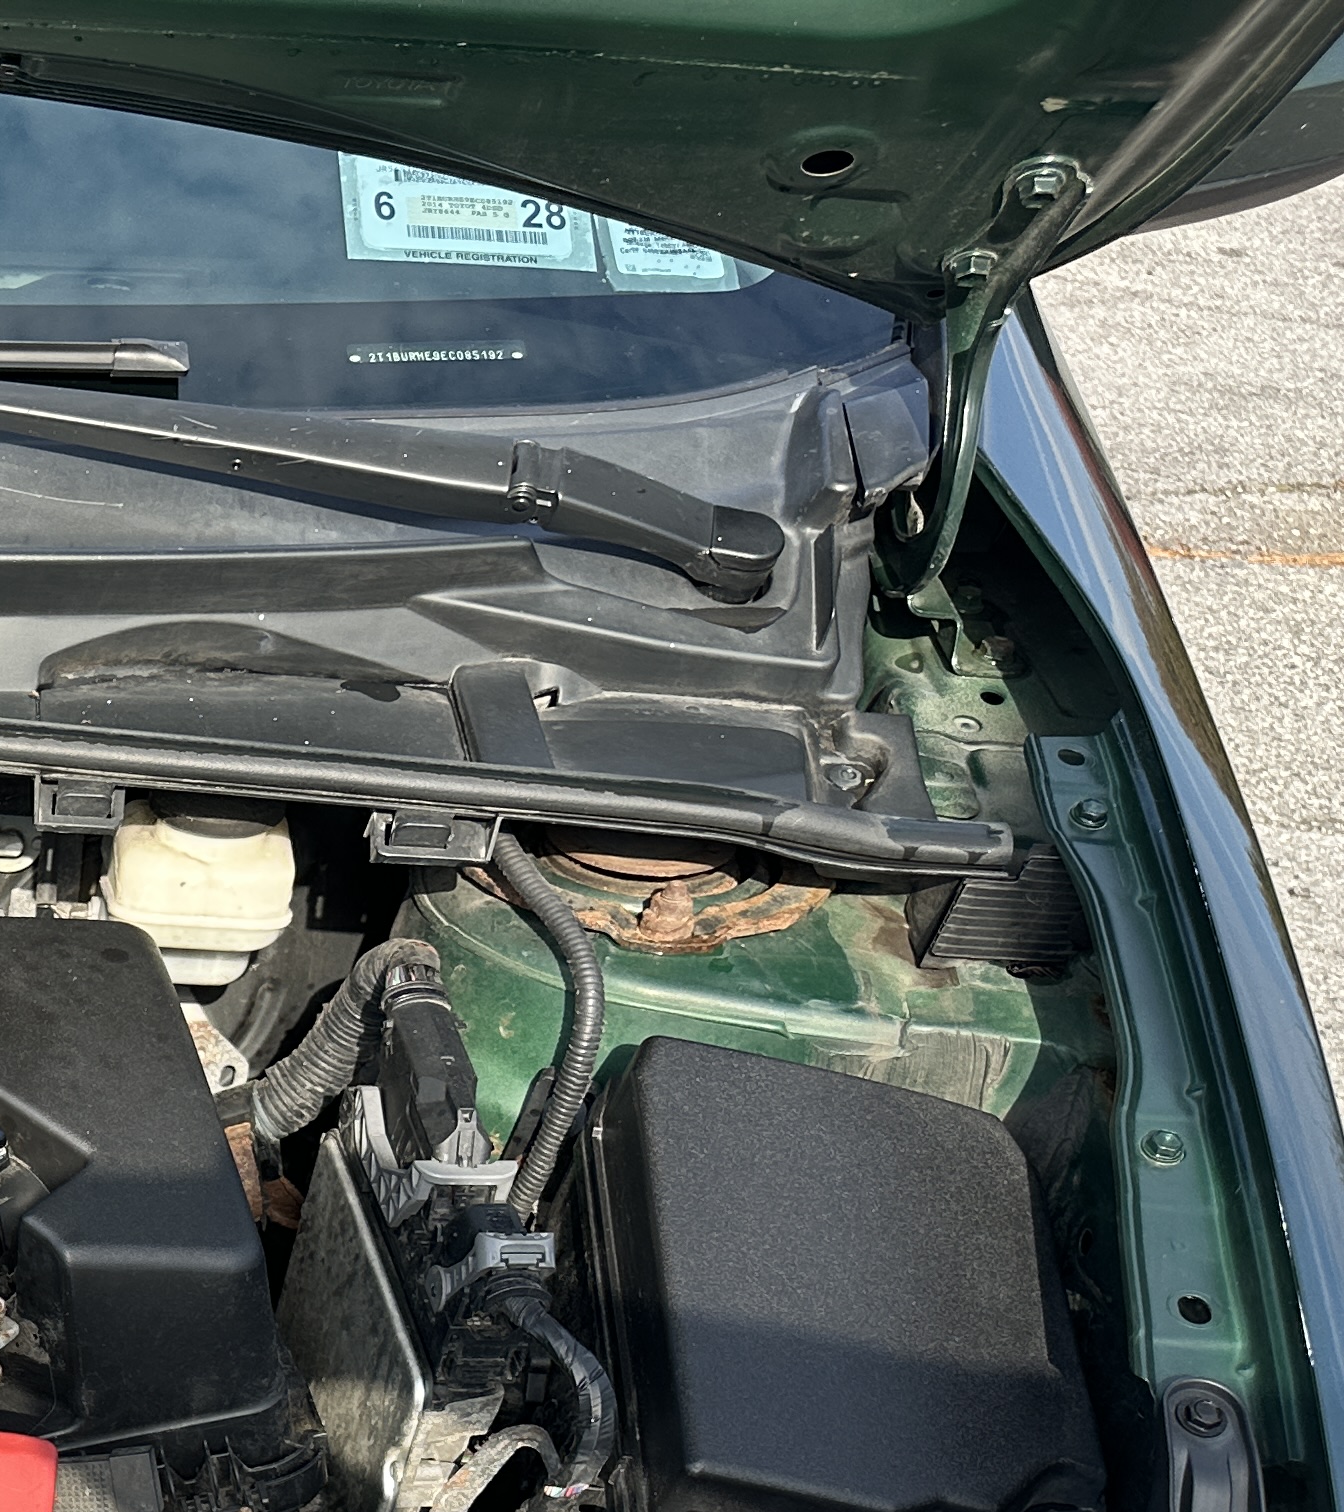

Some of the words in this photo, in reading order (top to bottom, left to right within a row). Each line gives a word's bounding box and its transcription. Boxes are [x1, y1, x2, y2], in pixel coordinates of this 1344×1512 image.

[374, 191, 396, 221] 6
[421, 200, 443, 208] 2014
[520, 198, 567, 230] 28
[404, 249, 452, 261] VEHICLE
[456, 252, 538, 265] REGISTRATION
